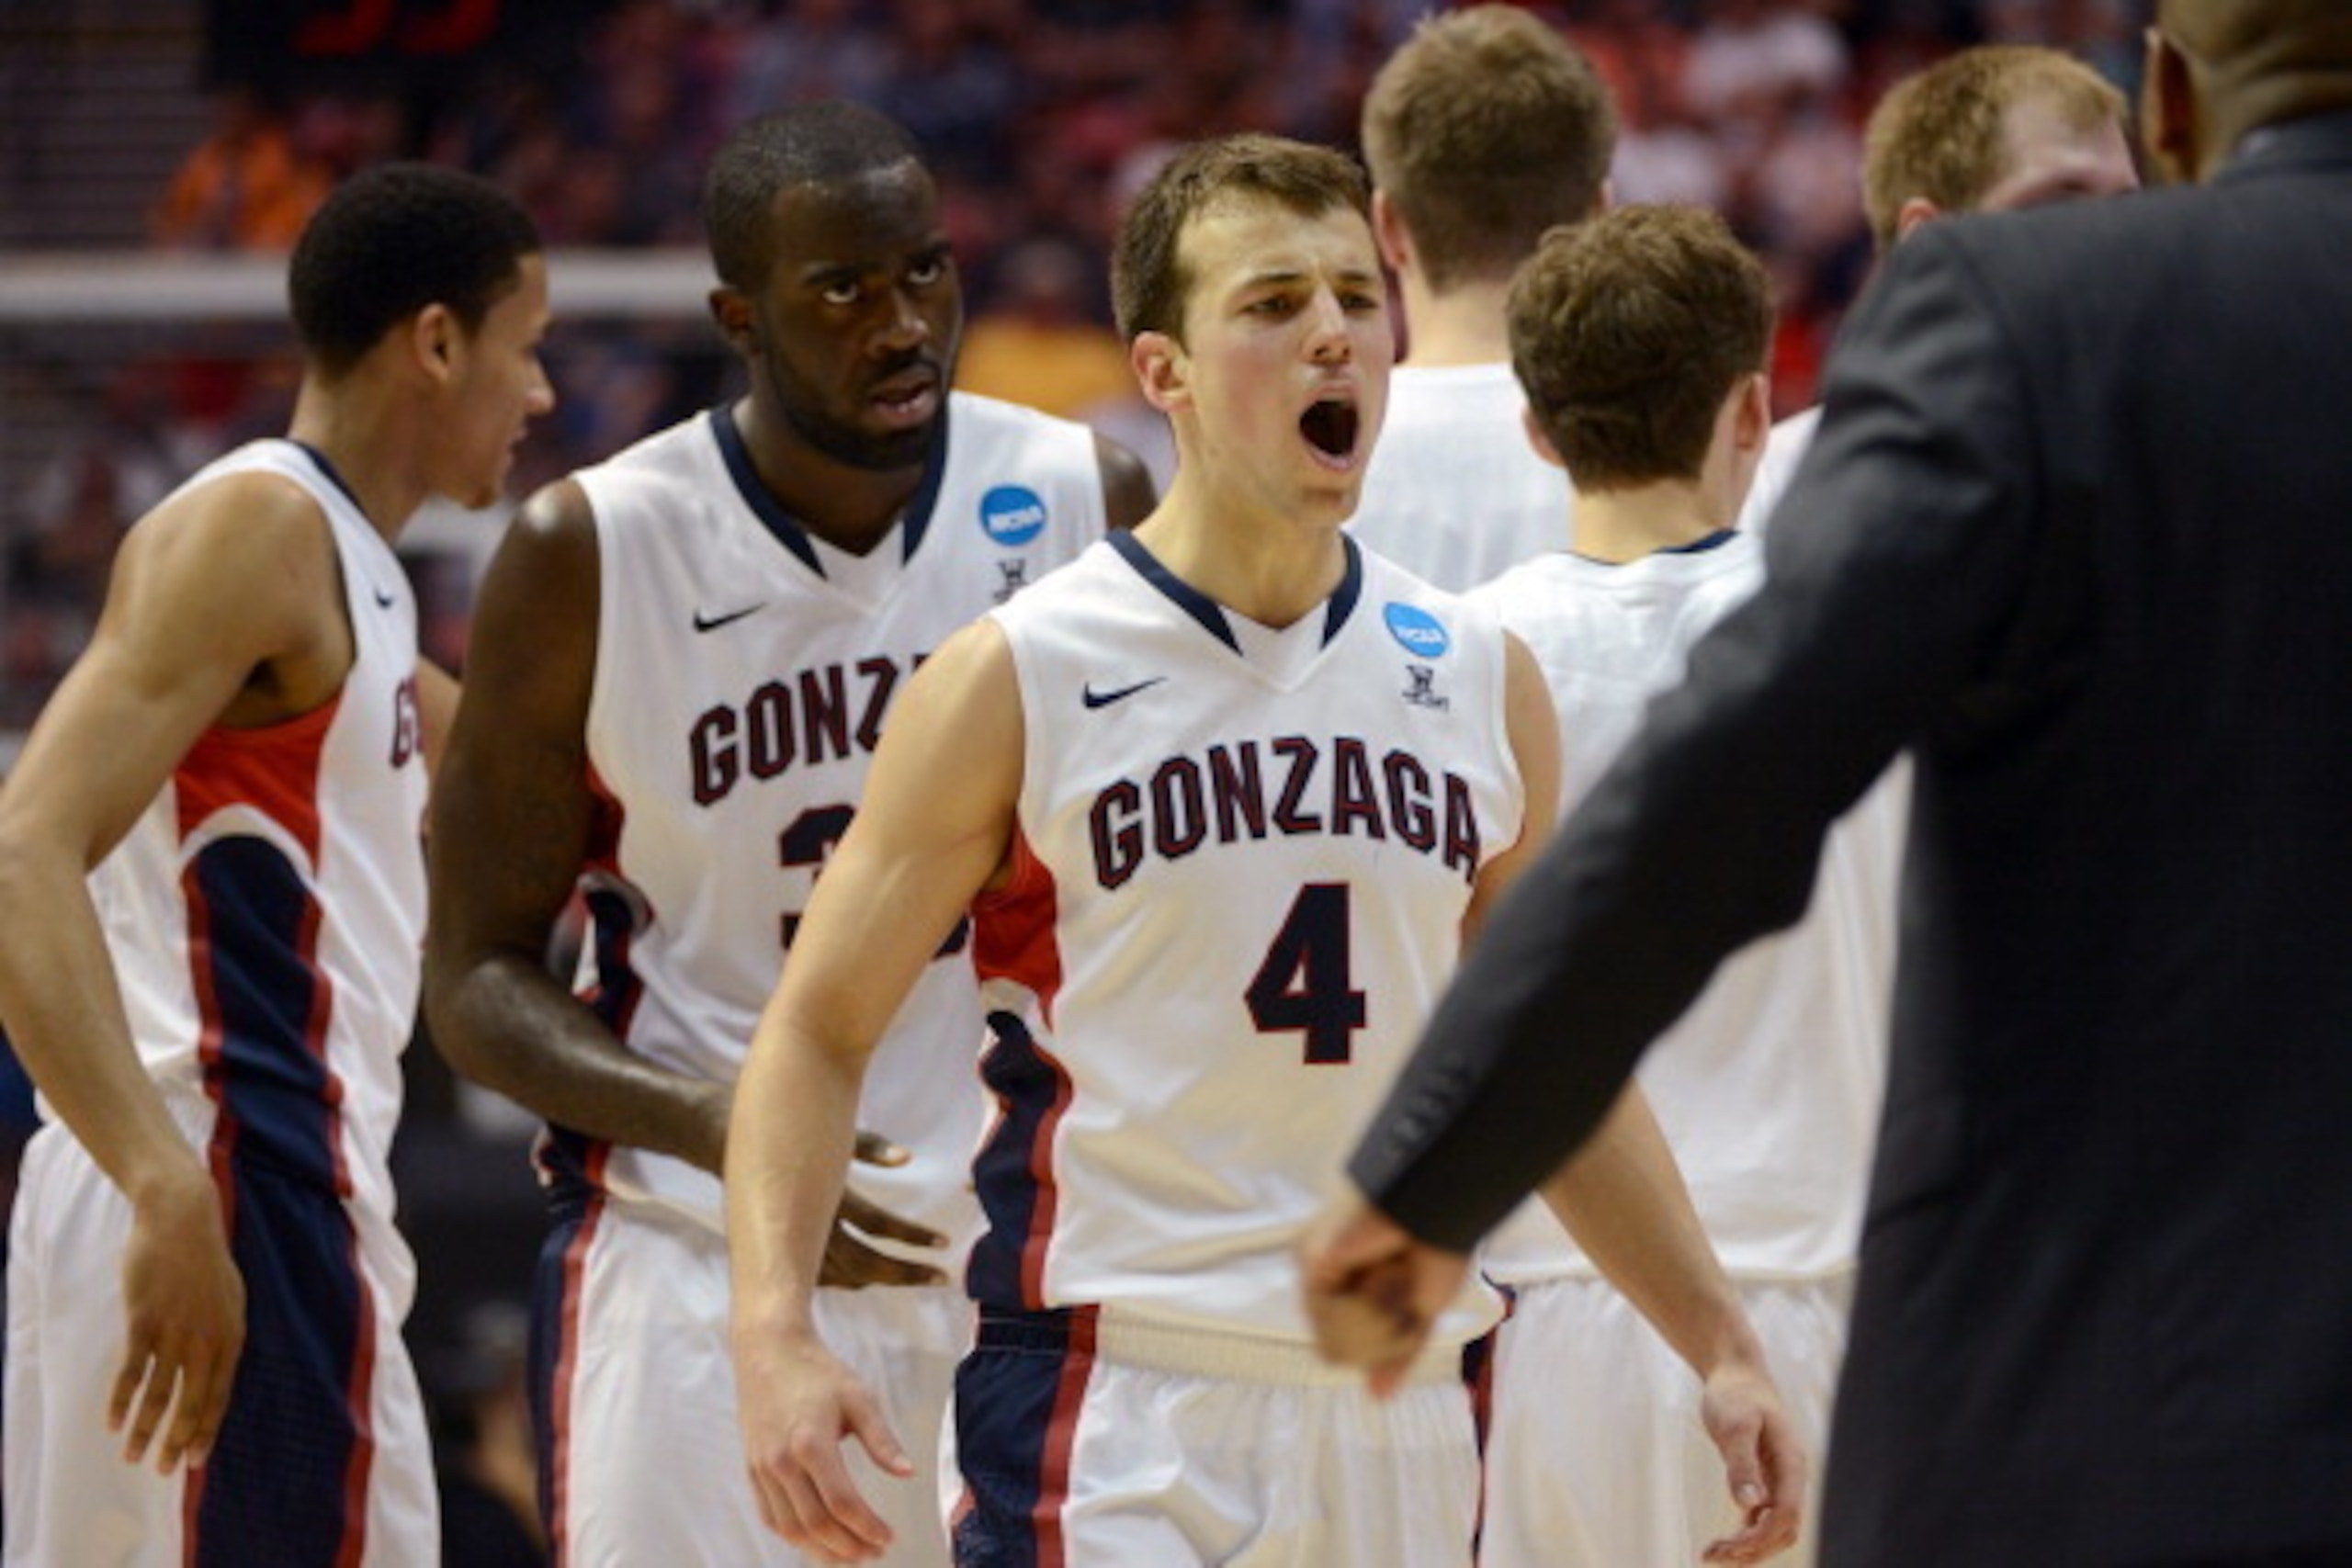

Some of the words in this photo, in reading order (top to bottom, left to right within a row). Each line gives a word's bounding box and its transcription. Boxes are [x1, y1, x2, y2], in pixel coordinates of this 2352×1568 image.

[689, 653, 930, 807] GONZ
[1090, 737, 1481, 889] GONZAGA
[1244, 882, 1366, 1066] 4
